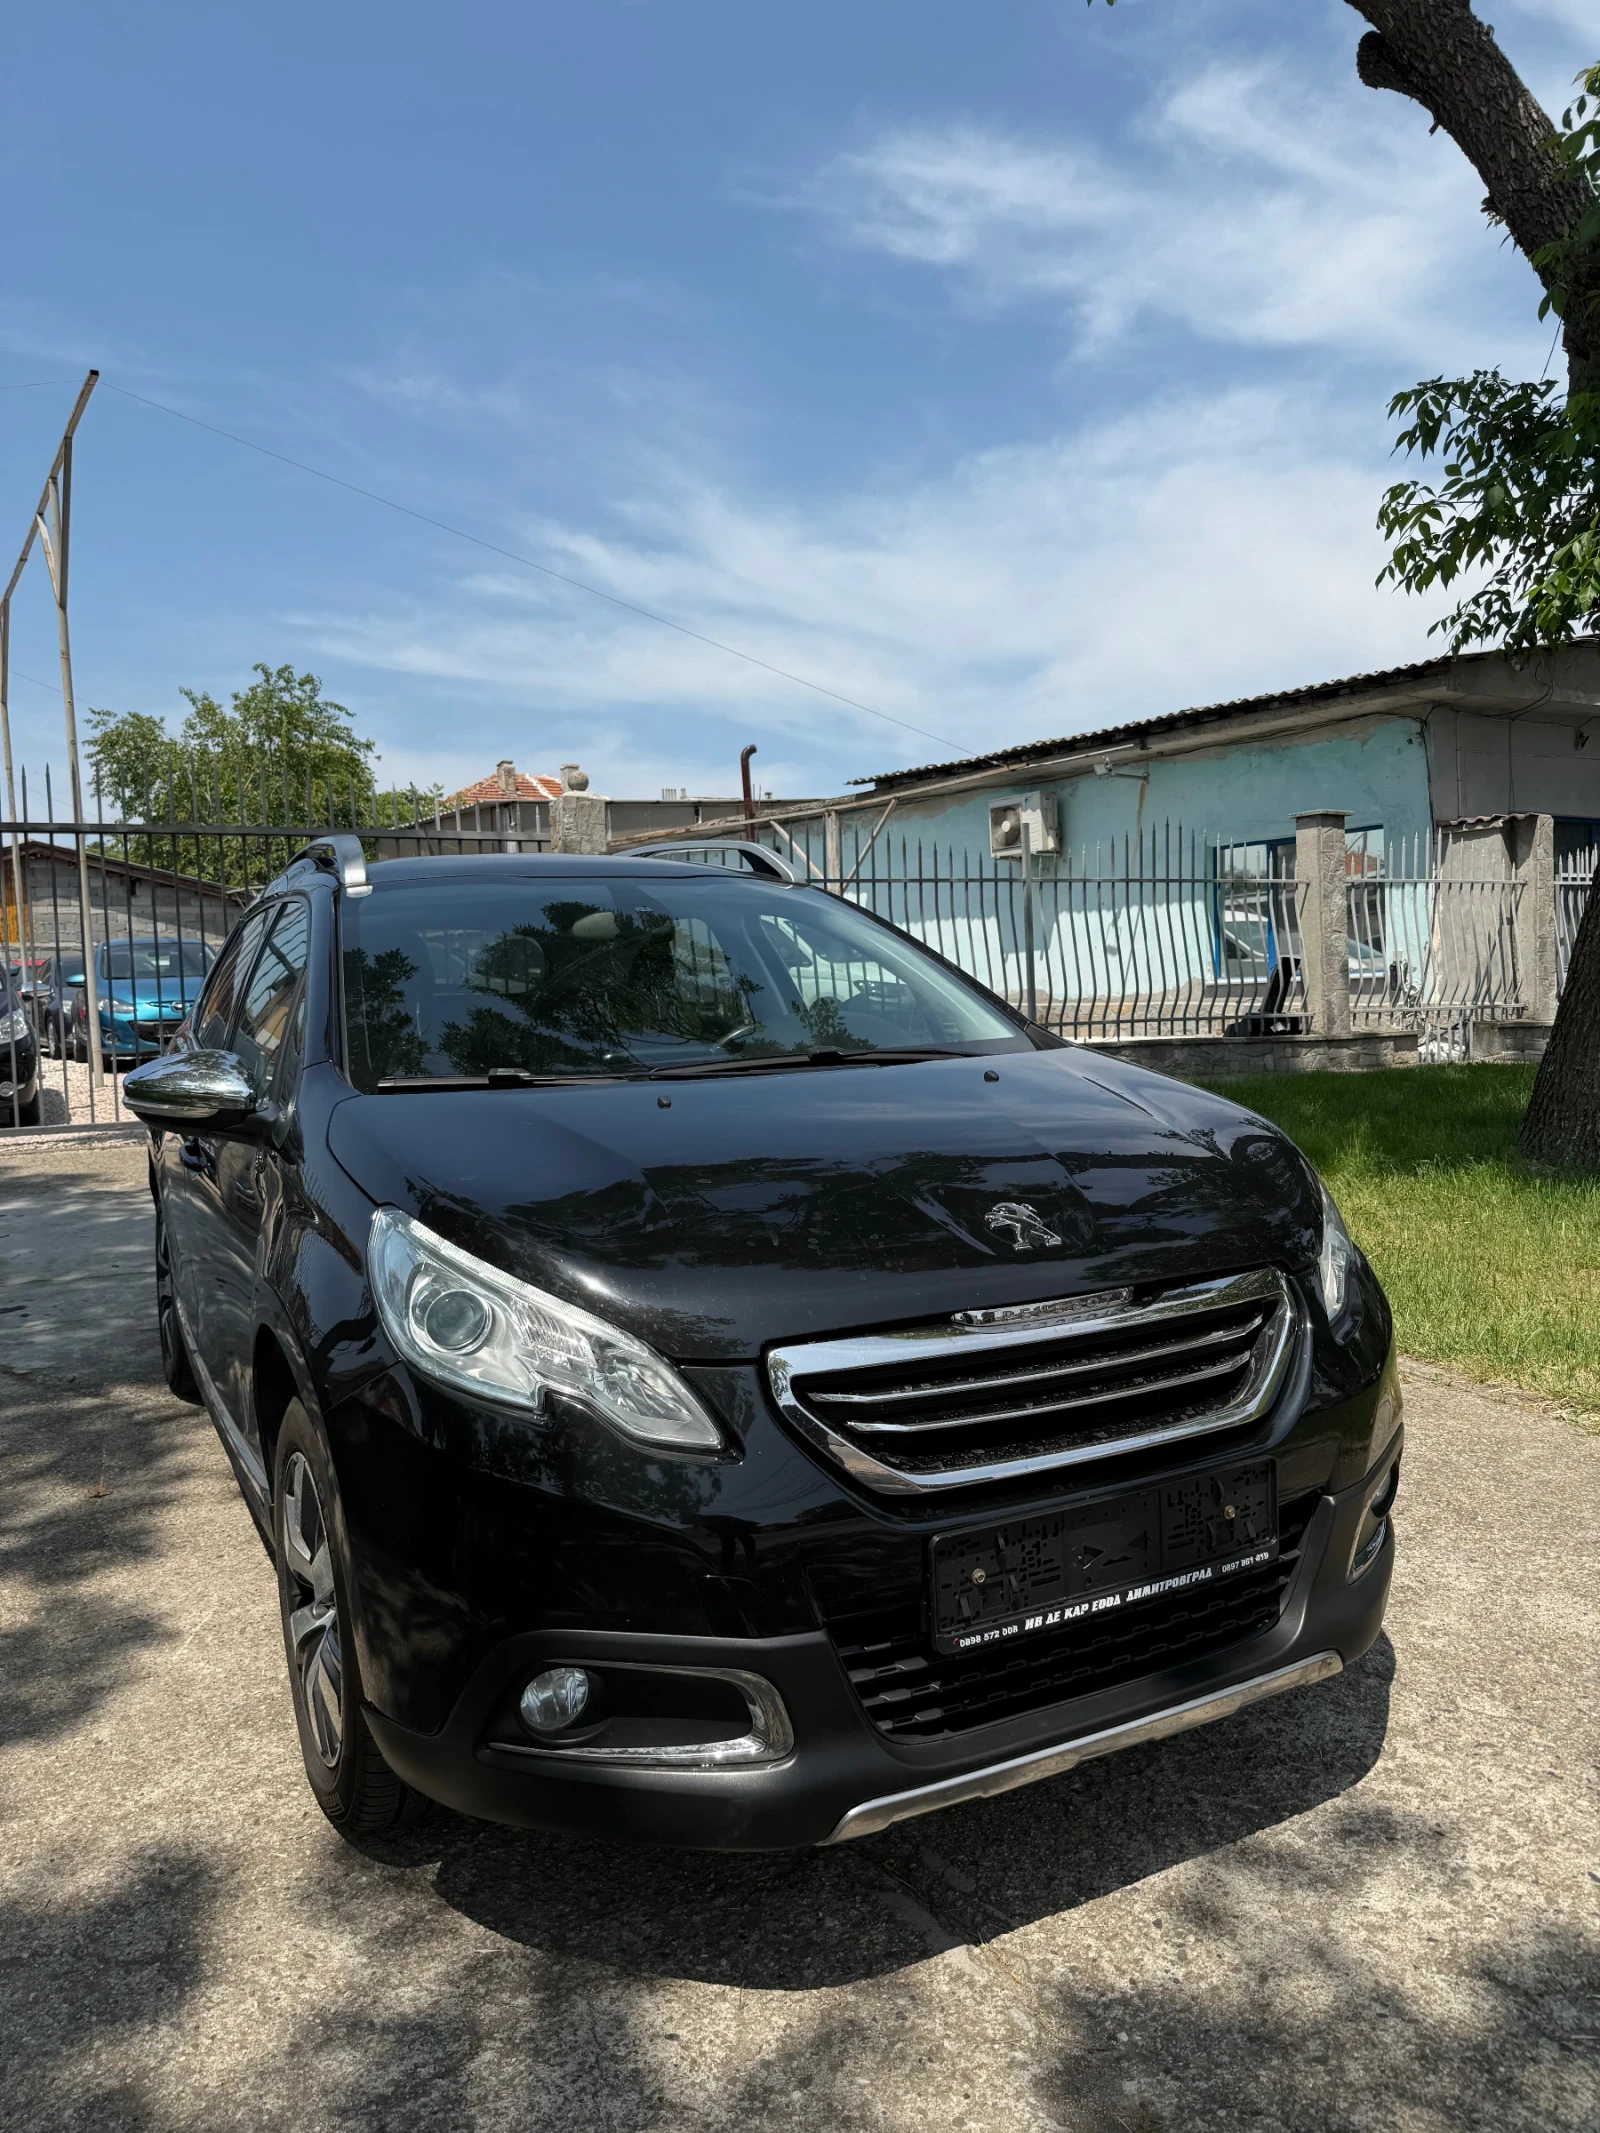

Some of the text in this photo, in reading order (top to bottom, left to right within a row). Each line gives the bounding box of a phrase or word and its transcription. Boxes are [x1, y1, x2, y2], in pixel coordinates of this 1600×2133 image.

[959, 1636, 982, 1647] 0898
[984, 1630, 1000, 1641] 572
[1024, 1616, 1043, 1630] ИВ
[1045, 1611, 1061, 1625] ДЕ
[1063, 1603, 1089, 1620] КАР
[1091, 1594, 1121, 1612] ЕООД
[1126, 1567, 1212, 1602] ДИМИТРОВГРАД
[1221, 1560, 1240, 1573] 0897
